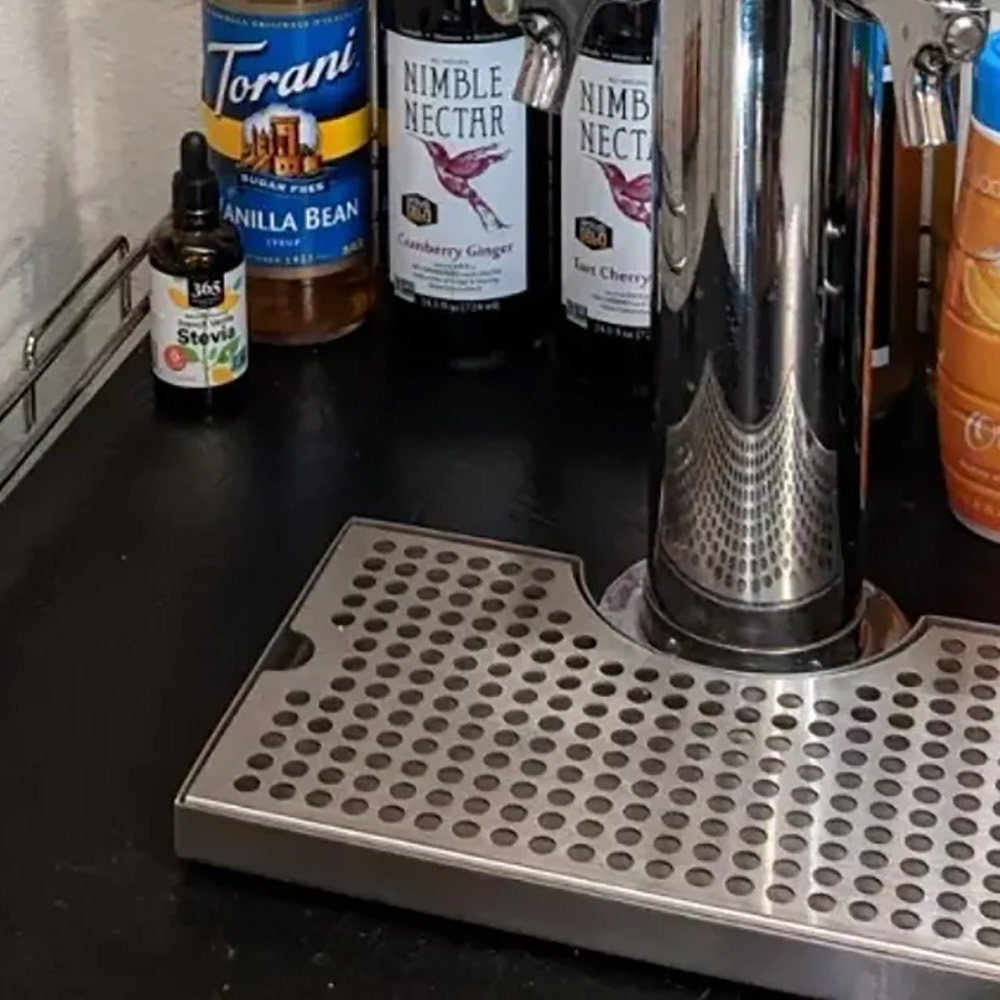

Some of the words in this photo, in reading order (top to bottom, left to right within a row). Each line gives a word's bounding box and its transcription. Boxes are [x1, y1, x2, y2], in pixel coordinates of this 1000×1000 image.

[207, 25, 357, 118] Torani
[404, 58, 503, 100] NIMBLE
[580, 78, 650, 121] NIMB
[404, 99, 506, 140] NECTAR
[580, 119, 652, 161] NECT
[240, 173, 287, 193] SUGAR
[304, 197, 360, 231] BEAN
[396, 231, 463, 262] Cranberry
[465, 242, 515, 261] Ginger
[189, 279, 222, 298] 365
[176, 325, 236, 347] Stevia
